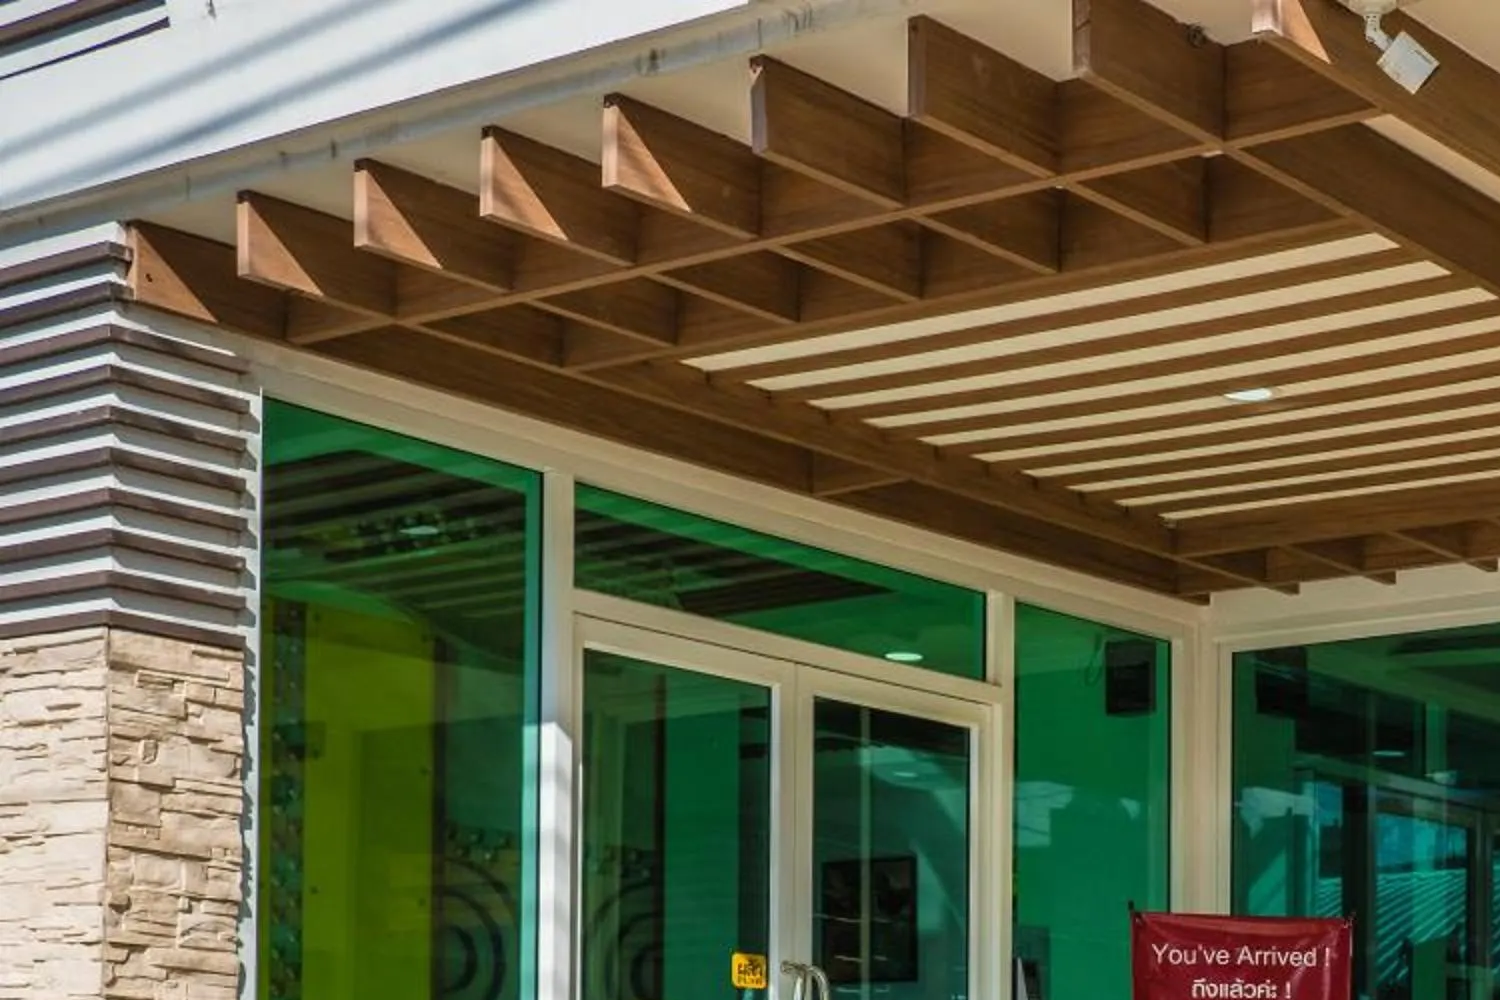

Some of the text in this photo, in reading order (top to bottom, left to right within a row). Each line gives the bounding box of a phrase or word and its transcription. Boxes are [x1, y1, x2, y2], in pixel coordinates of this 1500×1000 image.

[1151, 944, 1229, 966] You've
[1237, 946, 1317, 967] Arrived
[1191, 977, 1277, 999] ถึงแล้วค่ะ
